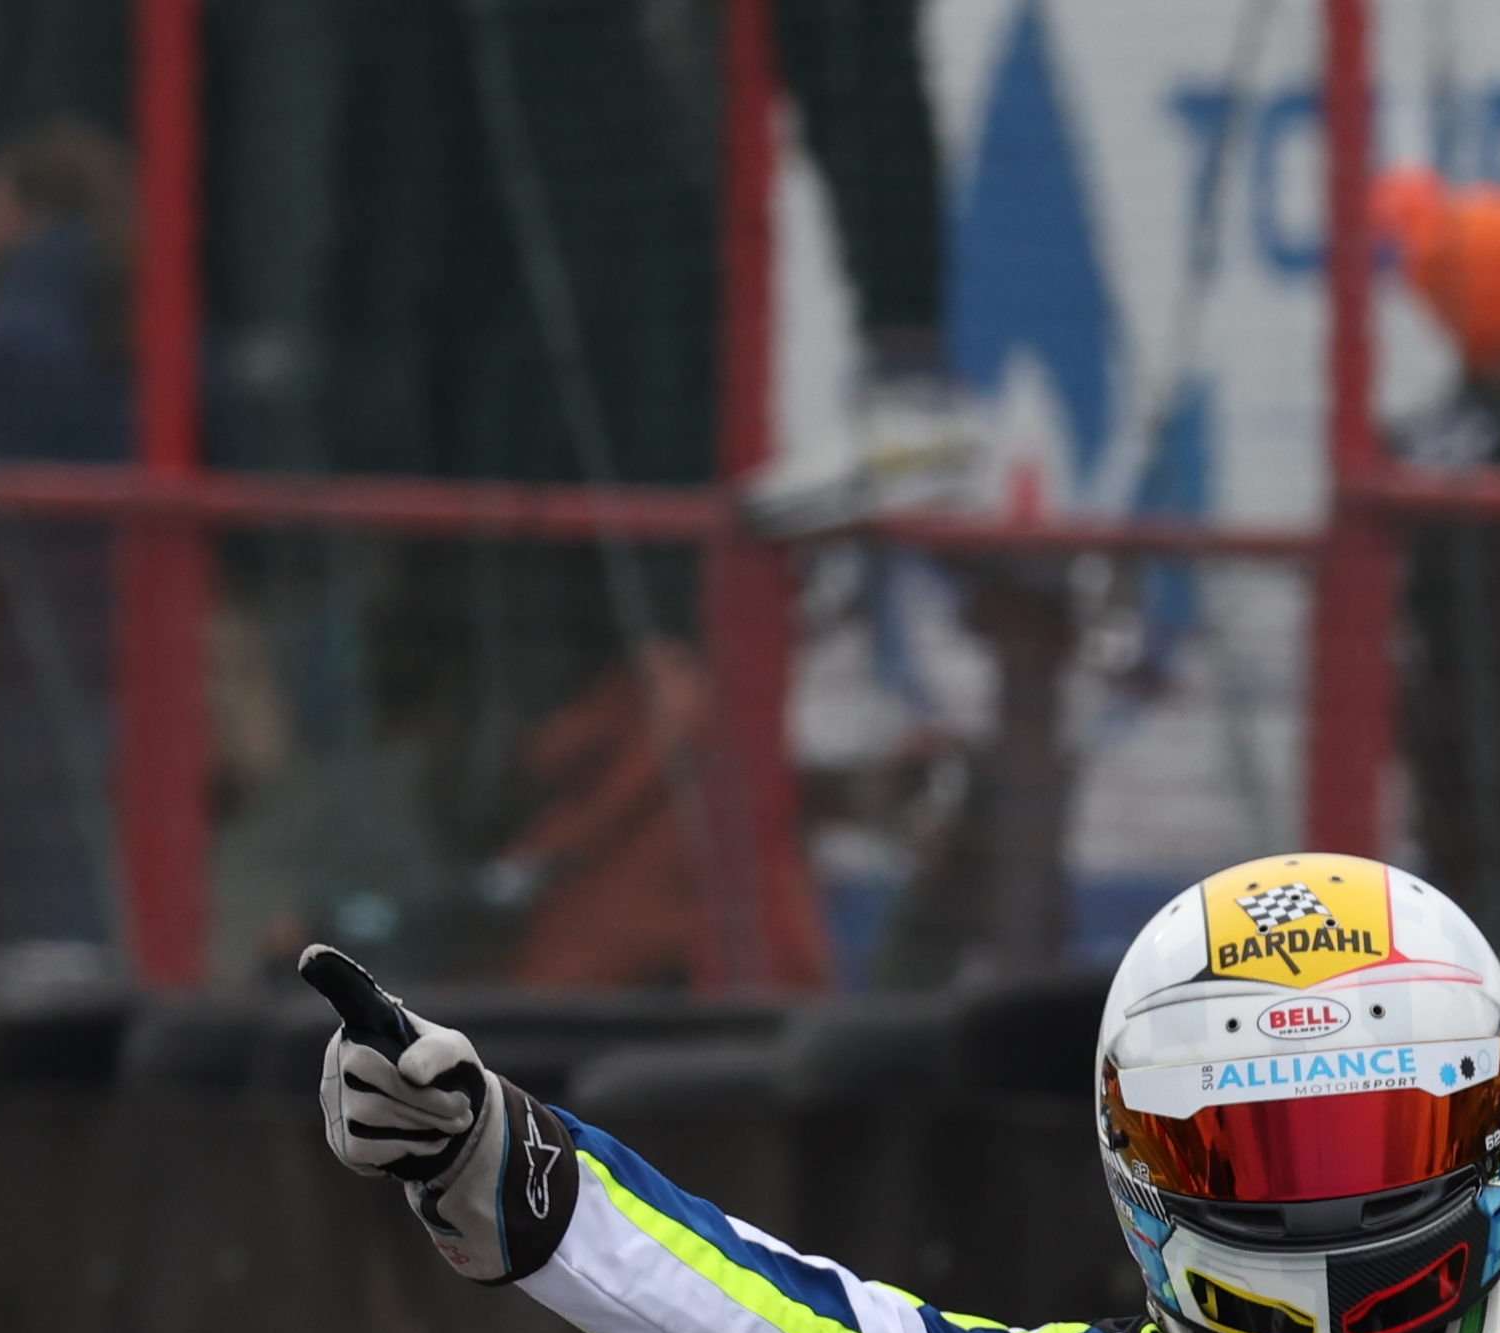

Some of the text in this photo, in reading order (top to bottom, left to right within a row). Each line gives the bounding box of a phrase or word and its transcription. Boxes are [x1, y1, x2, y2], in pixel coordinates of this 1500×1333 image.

[1218, 926, 1383, 976] BARDAHL
[1269, 1006, 1339, 1029] BELL
[1202, 1047, 1417, 1090] SUB ALLIANCE
[1294, 1076, 1417, 1097] MOTORSPORT
